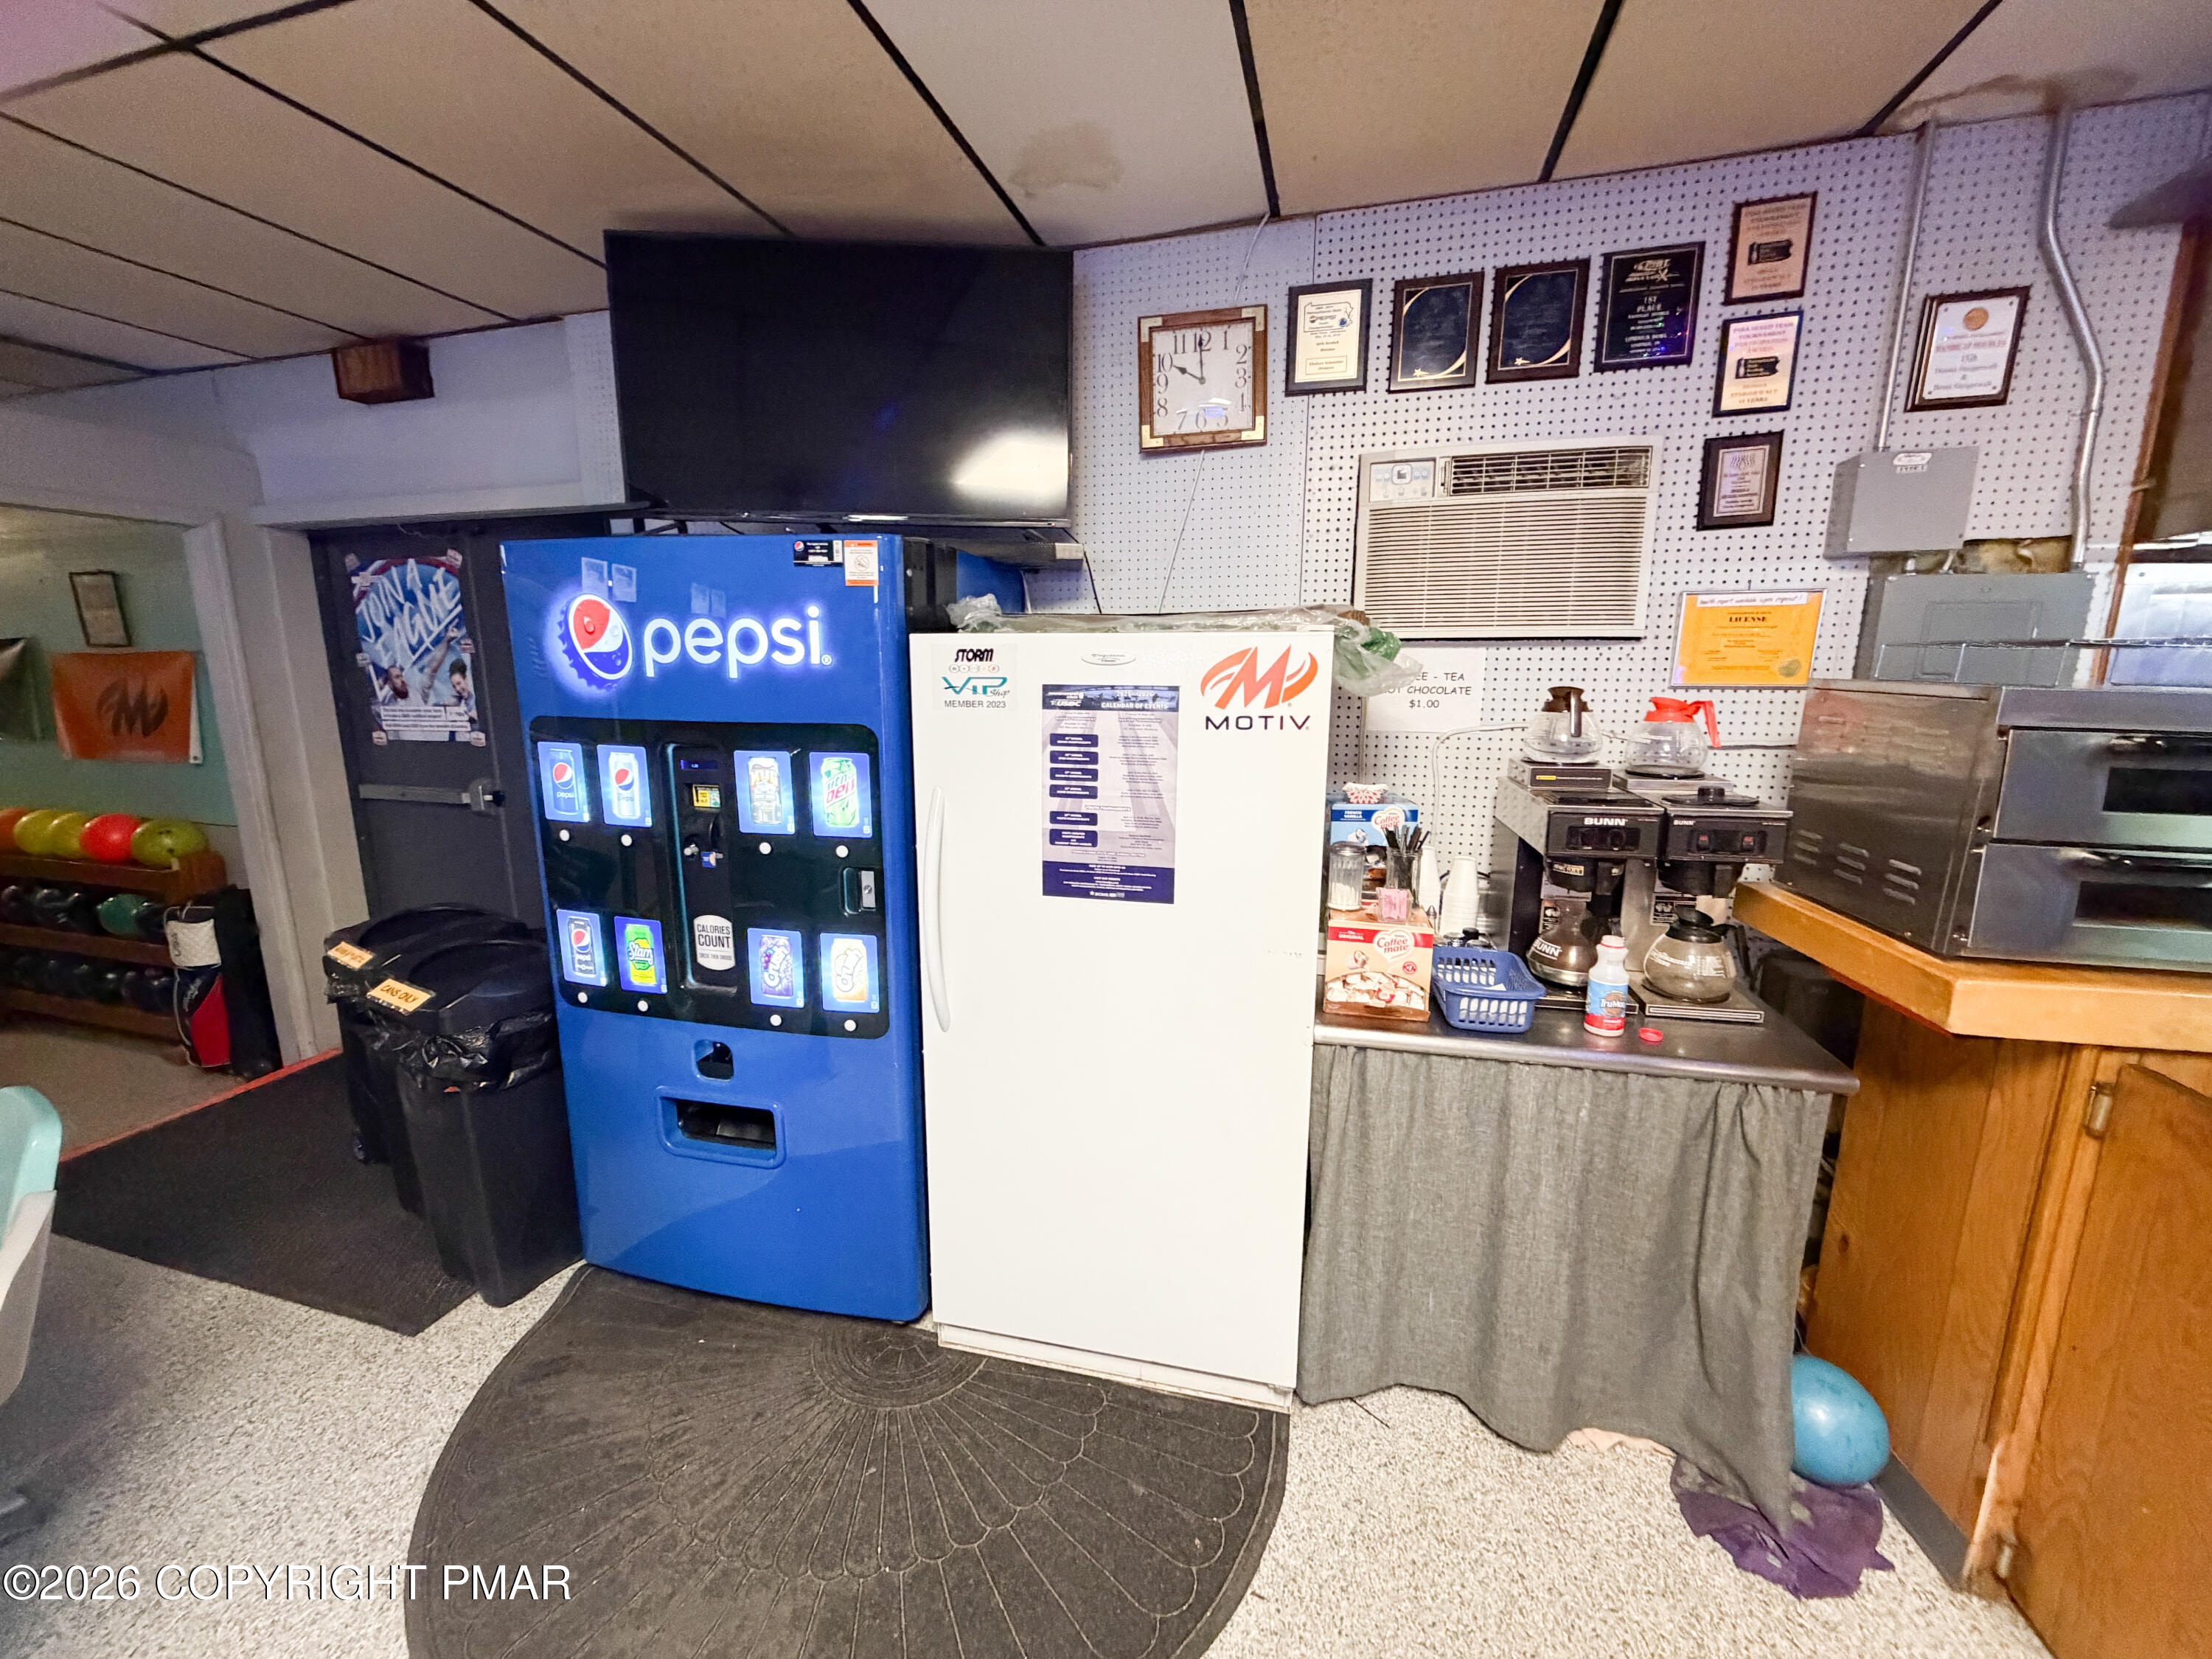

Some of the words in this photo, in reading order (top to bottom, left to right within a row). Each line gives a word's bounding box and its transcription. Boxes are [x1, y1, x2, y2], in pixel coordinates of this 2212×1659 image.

[1173, 334, 1186, 355] 11
[1194, 332, 1212, 352] 12
[1222, 330, 1229, 350] 1
[1158, 353, 1173, 372] 10
[1236, 344, 1248, 364] 2
[1157, 374, 1169, 394] 9
[1235, 368, 1247, 389] 3
[1157, 398, 1168, 417] 8
[1177, 410, 1188, 430] 7
[1195, 409, 1207, 428] 6
[406, 558, 422, 591] A
[644, 606, 821, 678] pepsi
[955, 648, 994, 662] STORM
[941, 676, 1008, 695] VIP
[1444, 672, 1465, 681] TEA
[1407, 686, 1472, 695] CHOCOLATE
[945, 700, 984, 709] MEMBER
[987, 700, 1006, 709] 2023
[1409, 700, 1440, 709] $1.00
[1206, 715, 1310, 731] MOTIV
[1374, 815, 1400, 825] Coffee
[1584, 817, 1625, 826] BUNN
[697, 924, 731, 935] CALORIES
[698, 934, 731, 949] COUNT
[1377, 937, 1408, 948] Coffee
[1384, 945, 1409, 954] mate
[380, 984, 399, 998] CANS
[399, 991, 419, 1004] ONLY
